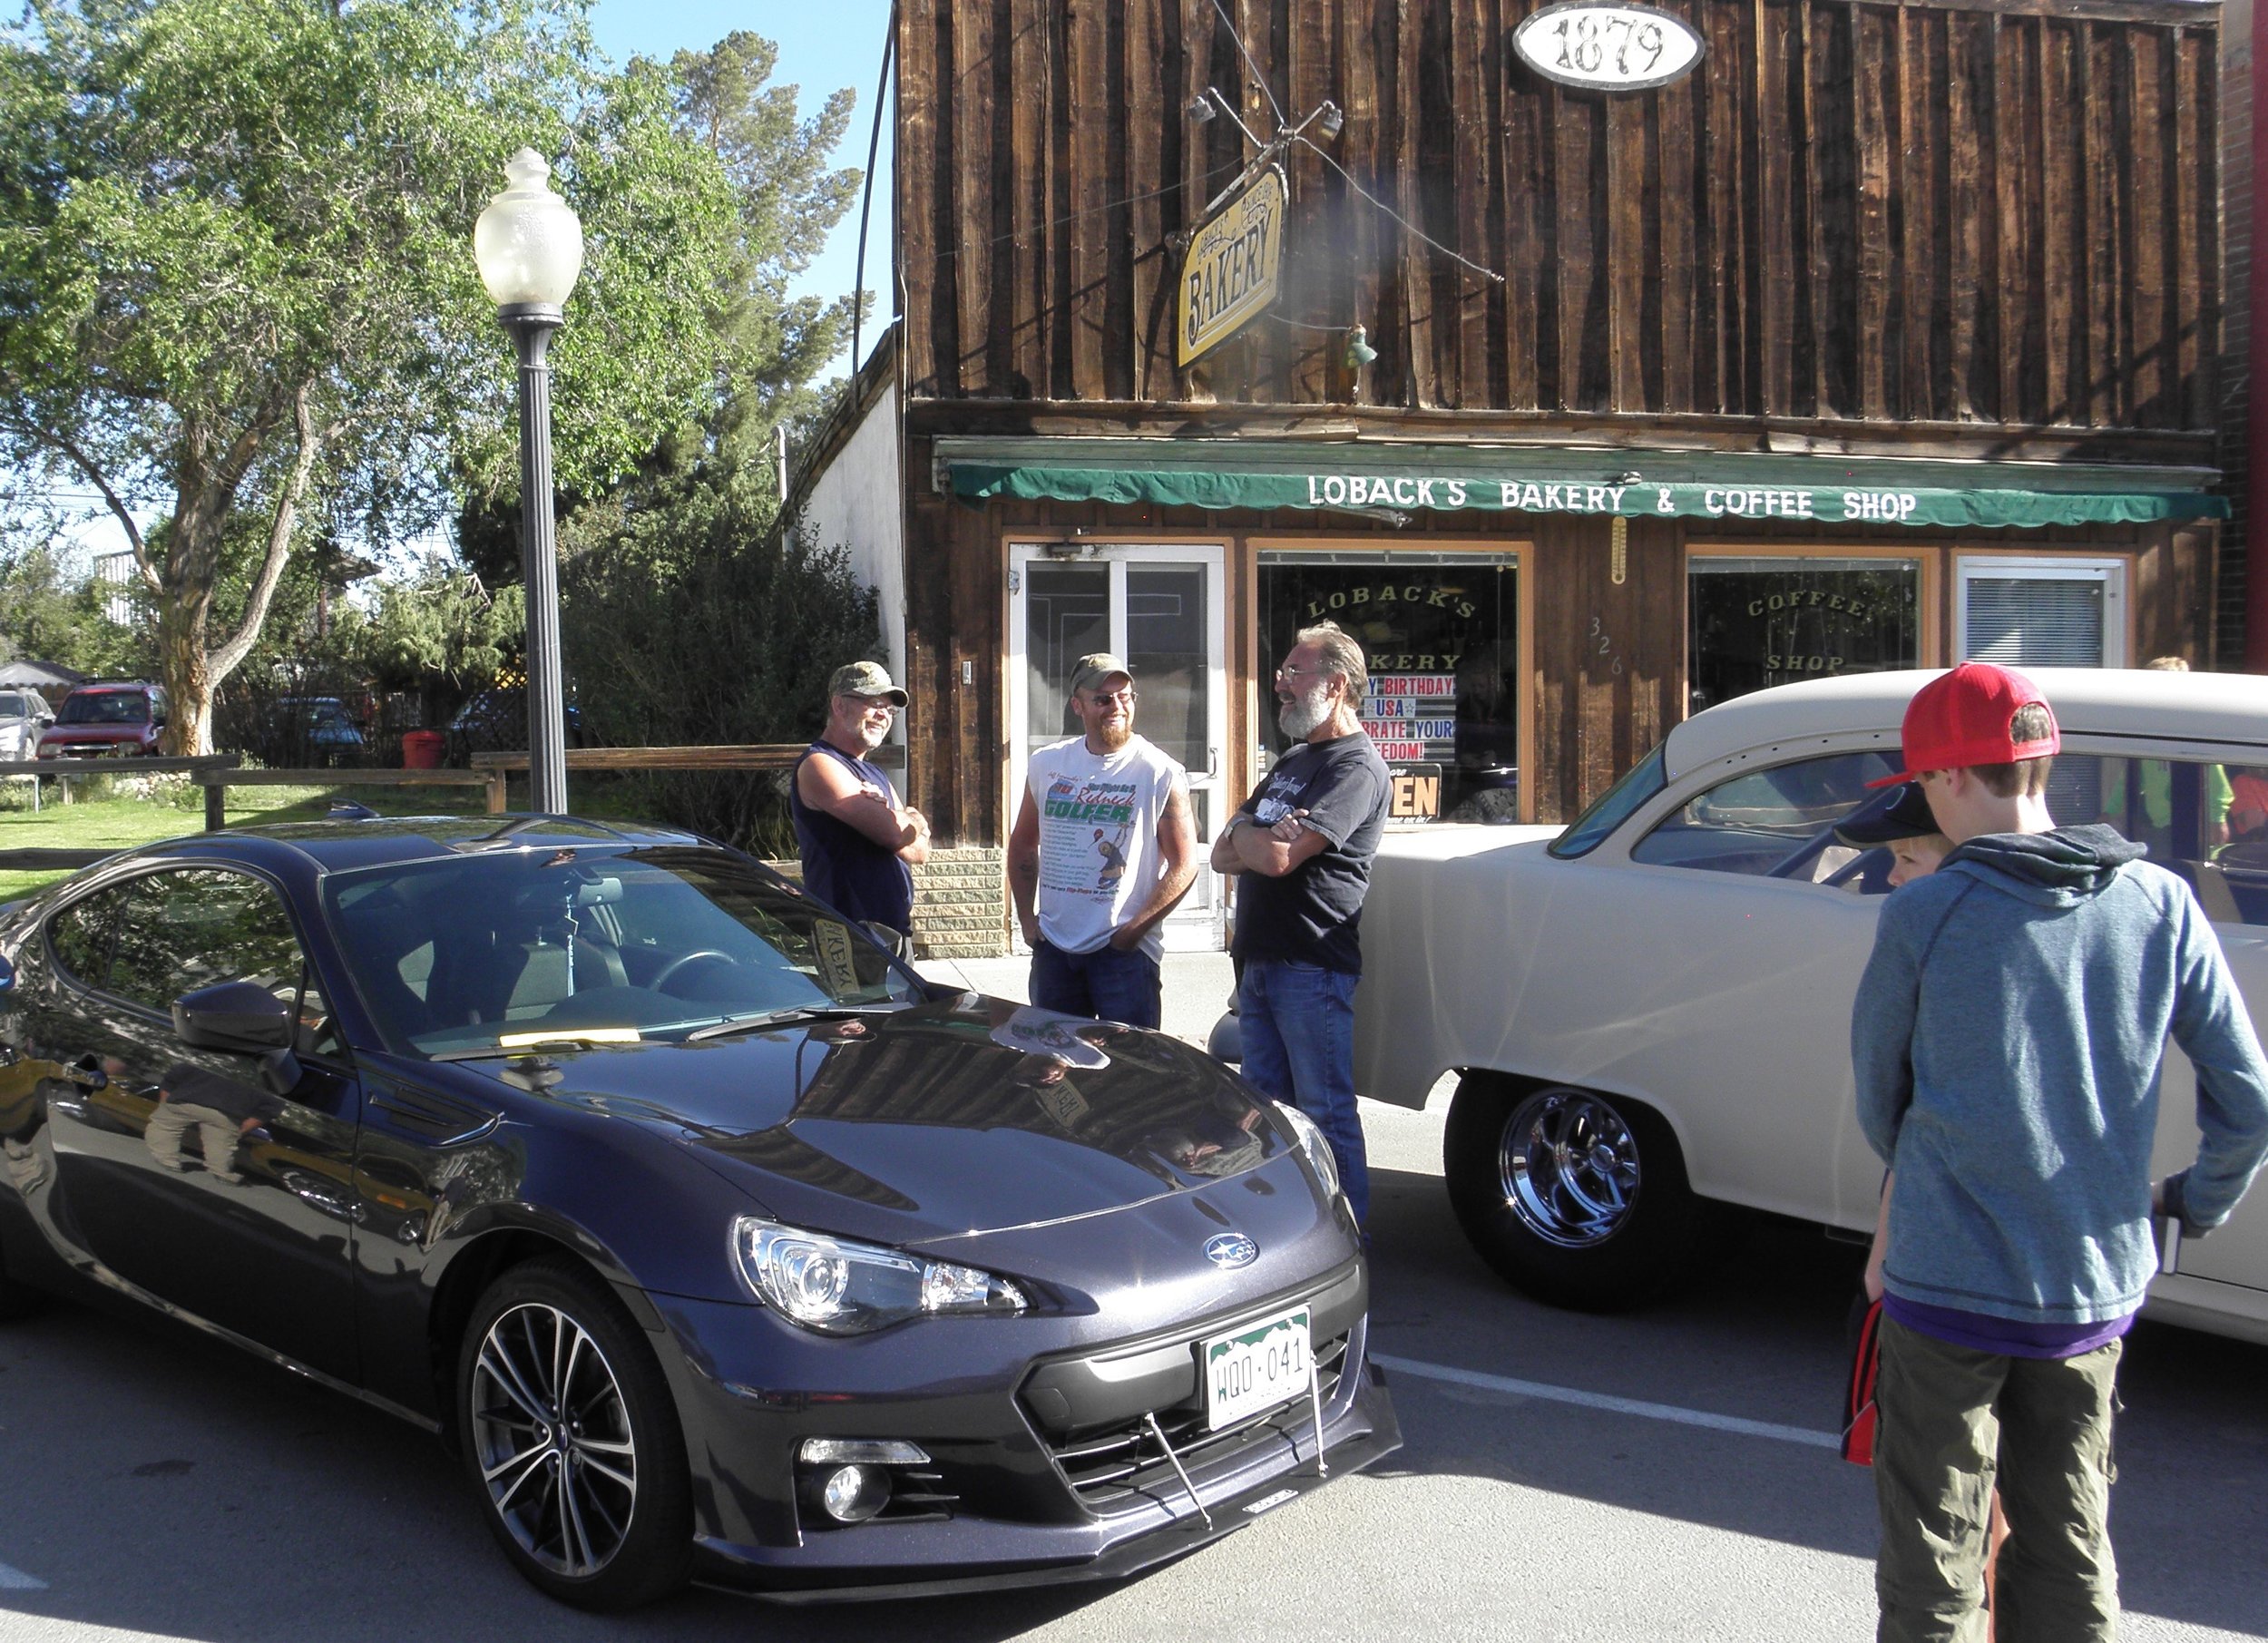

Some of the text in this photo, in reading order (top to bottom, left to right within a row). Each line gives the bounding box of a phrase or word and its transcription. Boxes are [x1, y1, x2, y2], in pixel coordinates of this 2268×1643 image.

[1552, 15, 1664, 74] 1879
[1188, 207, 1273, 347] BAKERY
[1308, 475, 1916, 520] LOBACK'S BAKERY & COFFEE SHOP
[1307, 585, 1476, 619] LOBACK'S
[1748, 591, 1865, 616] COFFEE
[1369, 654, 1461, 670] KERY
[1766, 655, 1844, 670] SHOP
[1384, 678, 1452, 695] BIRTHDAY
[1375, 699, 1403, 717] USA
[1361, 720, 1452, 738] BRATE YOUR
[1076, 786, 1137, 807] Redneck
[1393, 777, 1438, 816] EN
[1044, 799, 1133, 823] GOLFER
